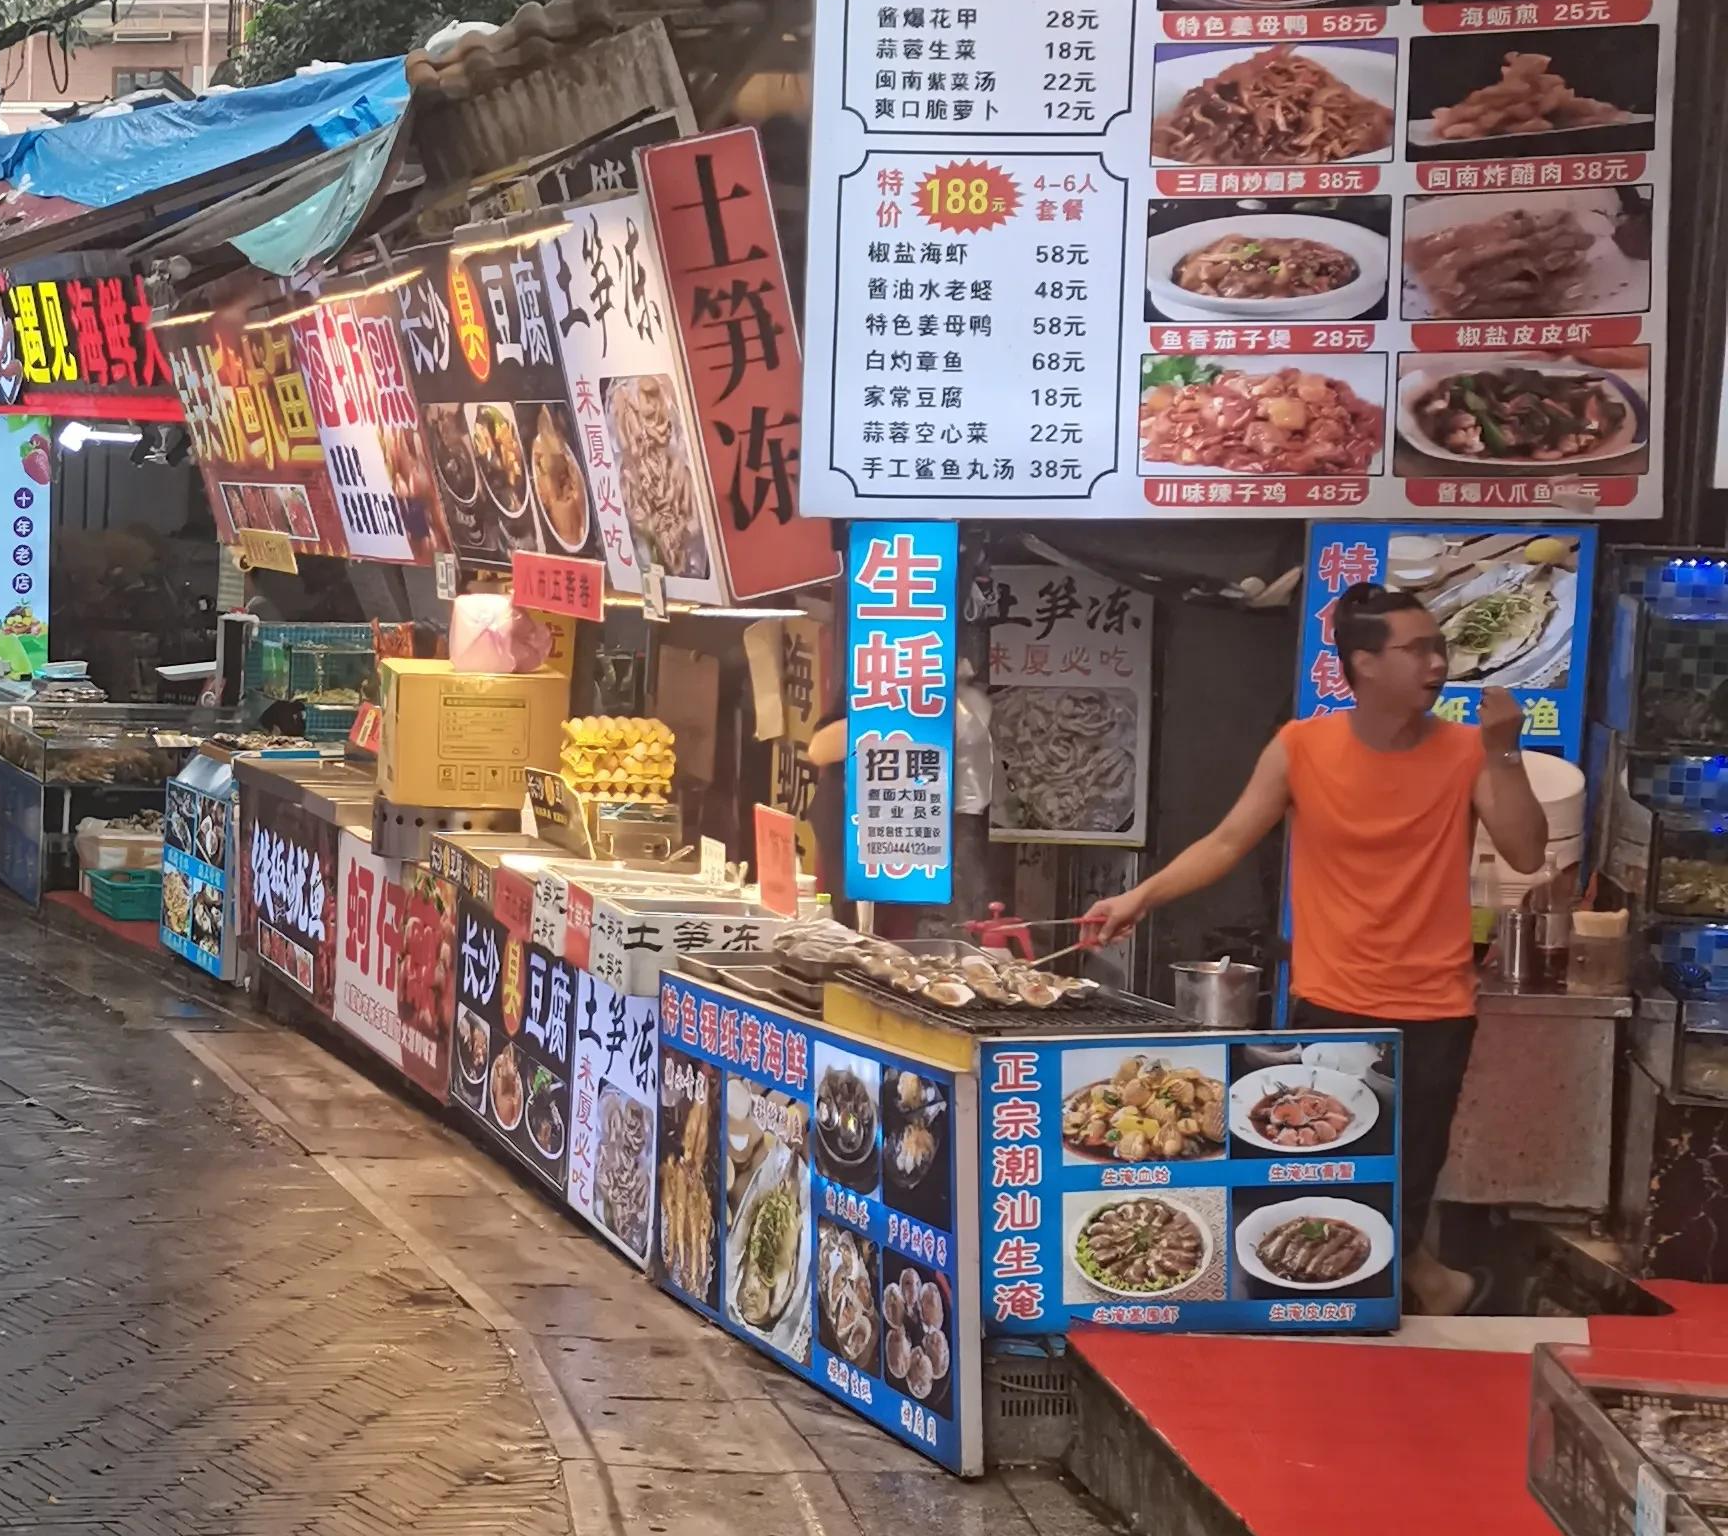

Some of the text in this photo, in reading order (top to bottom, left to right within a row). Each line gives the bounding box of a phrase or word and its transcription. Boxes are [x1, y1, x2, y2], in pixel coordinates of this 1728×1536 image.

[1046, 10, 1100, 31] 28元
[1554, 1, 1612, 22] 25元
[1322, 13, 1379, 33] 58元
[1045, 41, 1096, 62] 18元
[1043, 73, 1097, 93] 22元
[1044, 101, 1096, 121] 12元
[1318, 170, 1364, 190] 38元
[1572, 159, 1630, 181] 38元
[876, 169, 904, 229] 特价
[868, 241, 1090, 265] 椒盐海虾 58元
[1035, 280, 1089, 302] 48元
[400, 249, 554, 381] 长沙臭豆腐
[865, 314, 1087, 338] 特色姜母鸭 58元
[672, 154, 802, 532] 土笋冻
[1313, 326, 1369, 348] 28元
[1456, 324, 1594, 346] 椒盐皮皮虾
[866, 351, 1086, 373] 白灼章鱼 68元
[864, 386, 1083, 409] 家常豆腐 18元
[1030, 424, 1084, 445] 22元
[1029, 459, 1083, 481] 38元
[1307, 482, 1362, 502] 48元
[851, 534, 946, 718] 生蚝
[866, 749, 941, 782] 招聘
[624, 921, 763, 952] 土笋冻
[461, 913, 572, 1064] 长沙臭豆腐
